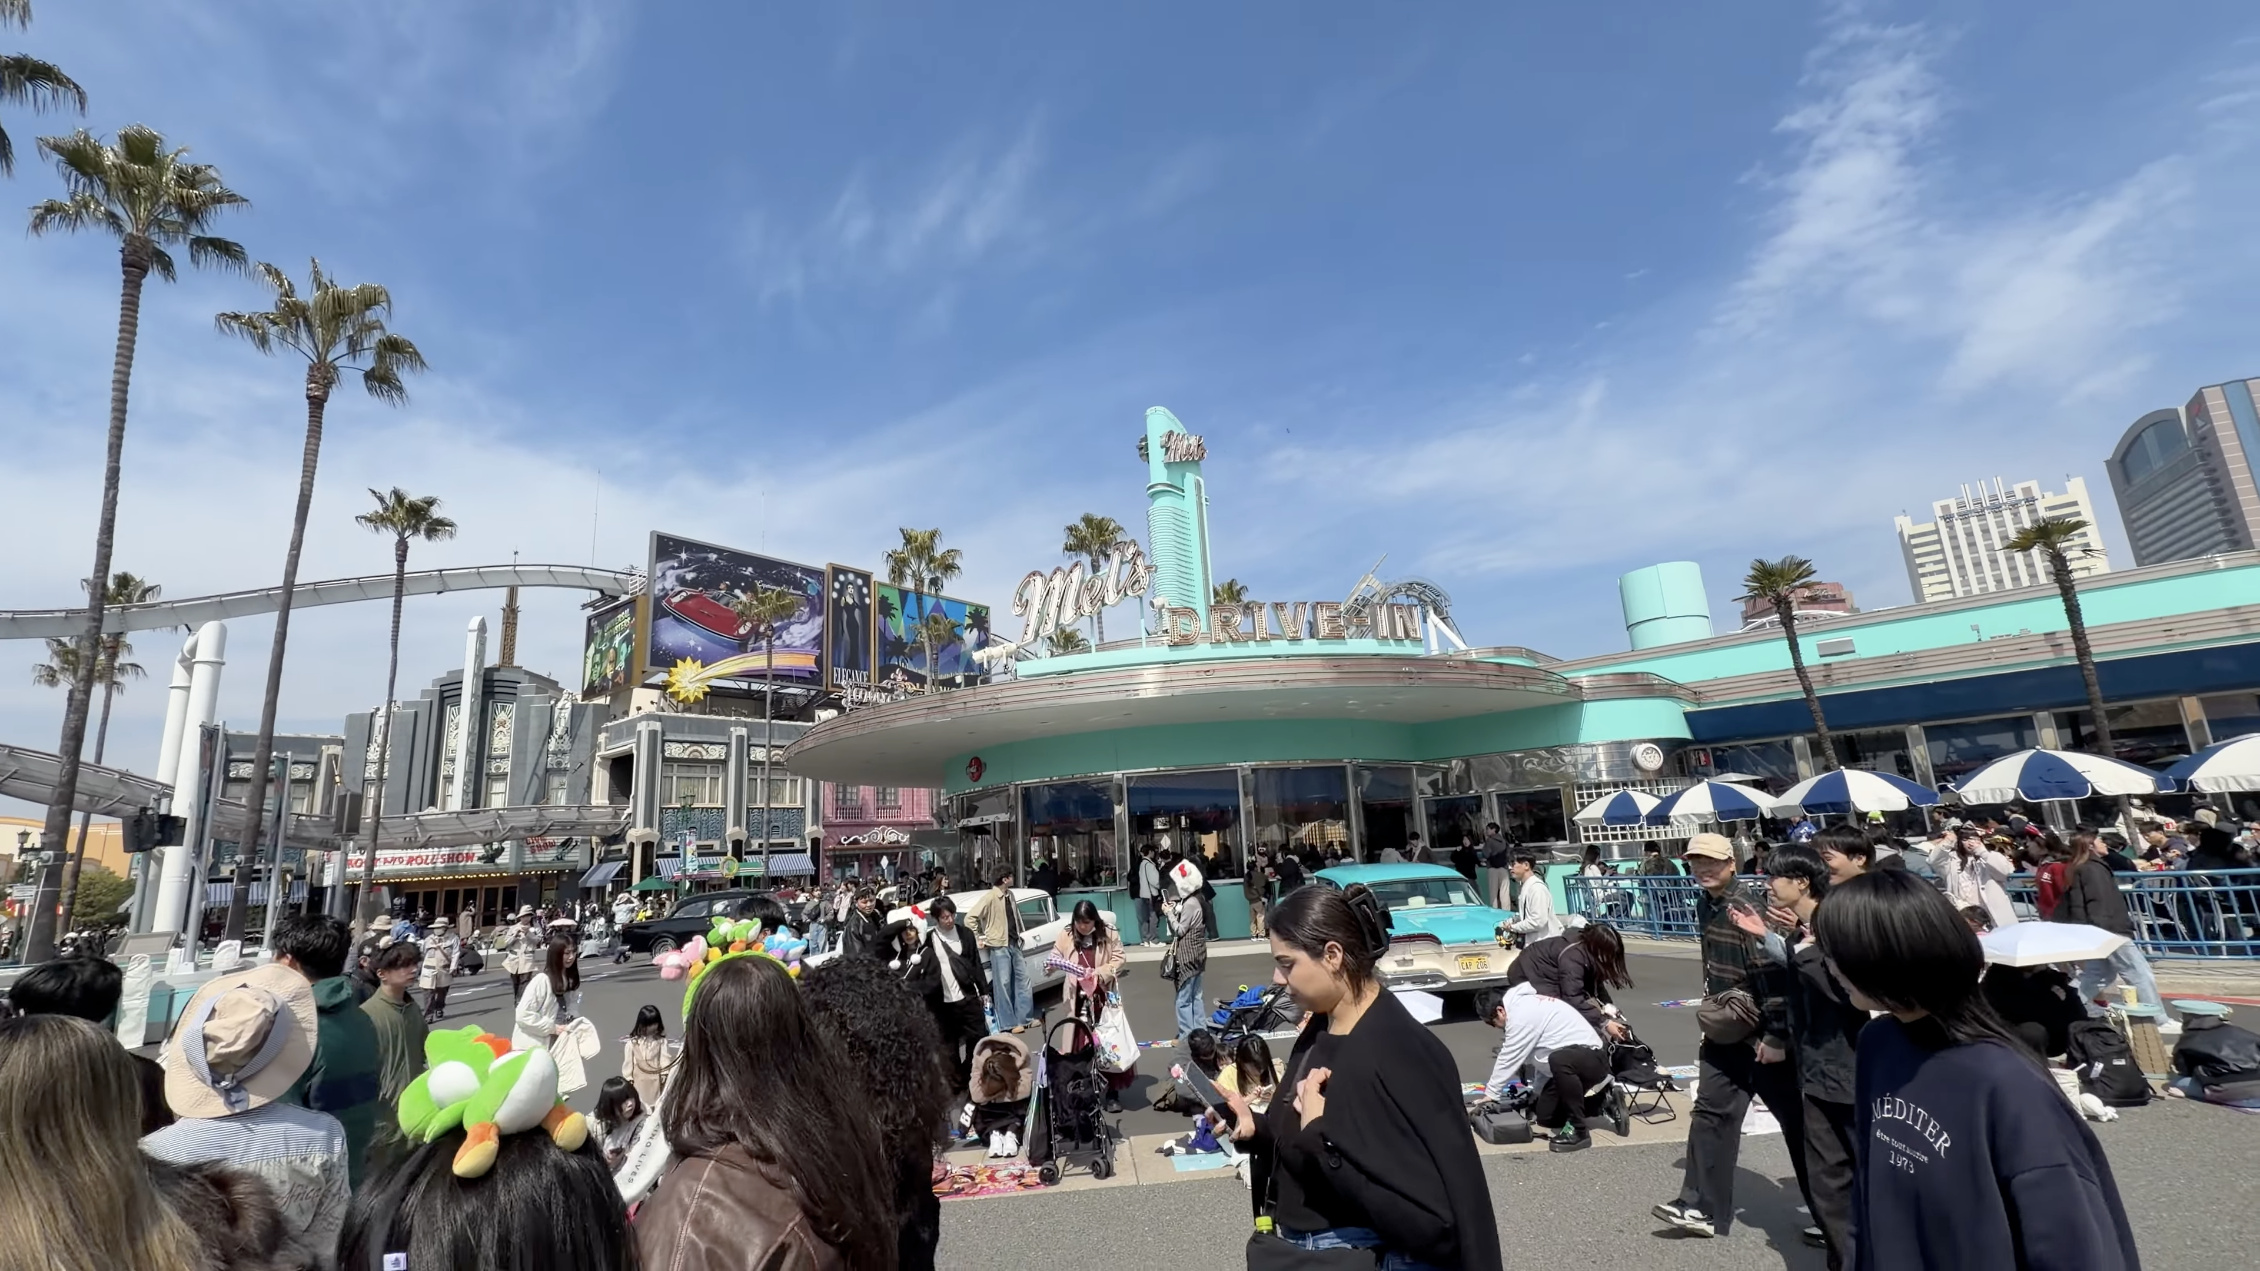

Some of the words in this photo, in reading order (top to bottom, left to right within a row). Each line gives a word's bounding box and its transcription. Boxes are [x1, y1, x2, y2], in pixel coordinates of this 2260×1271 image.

[1013, 539, 1157, 647] Mel's
[1168, 602, 1423, 646] DRIVE-IN
[833, 667, 869, 685] ELEGANCE
[405, 855, 437, 867] ROLL
[440, 852, 476, 864] SHOW
[1460, 961, 1473, 971] CAP
[1872, 1092, 1951, 1159] MÉDITER
[628, 1152, 647, 1184] LIVES
[1888, 1150, 1915, 1174] 1973
